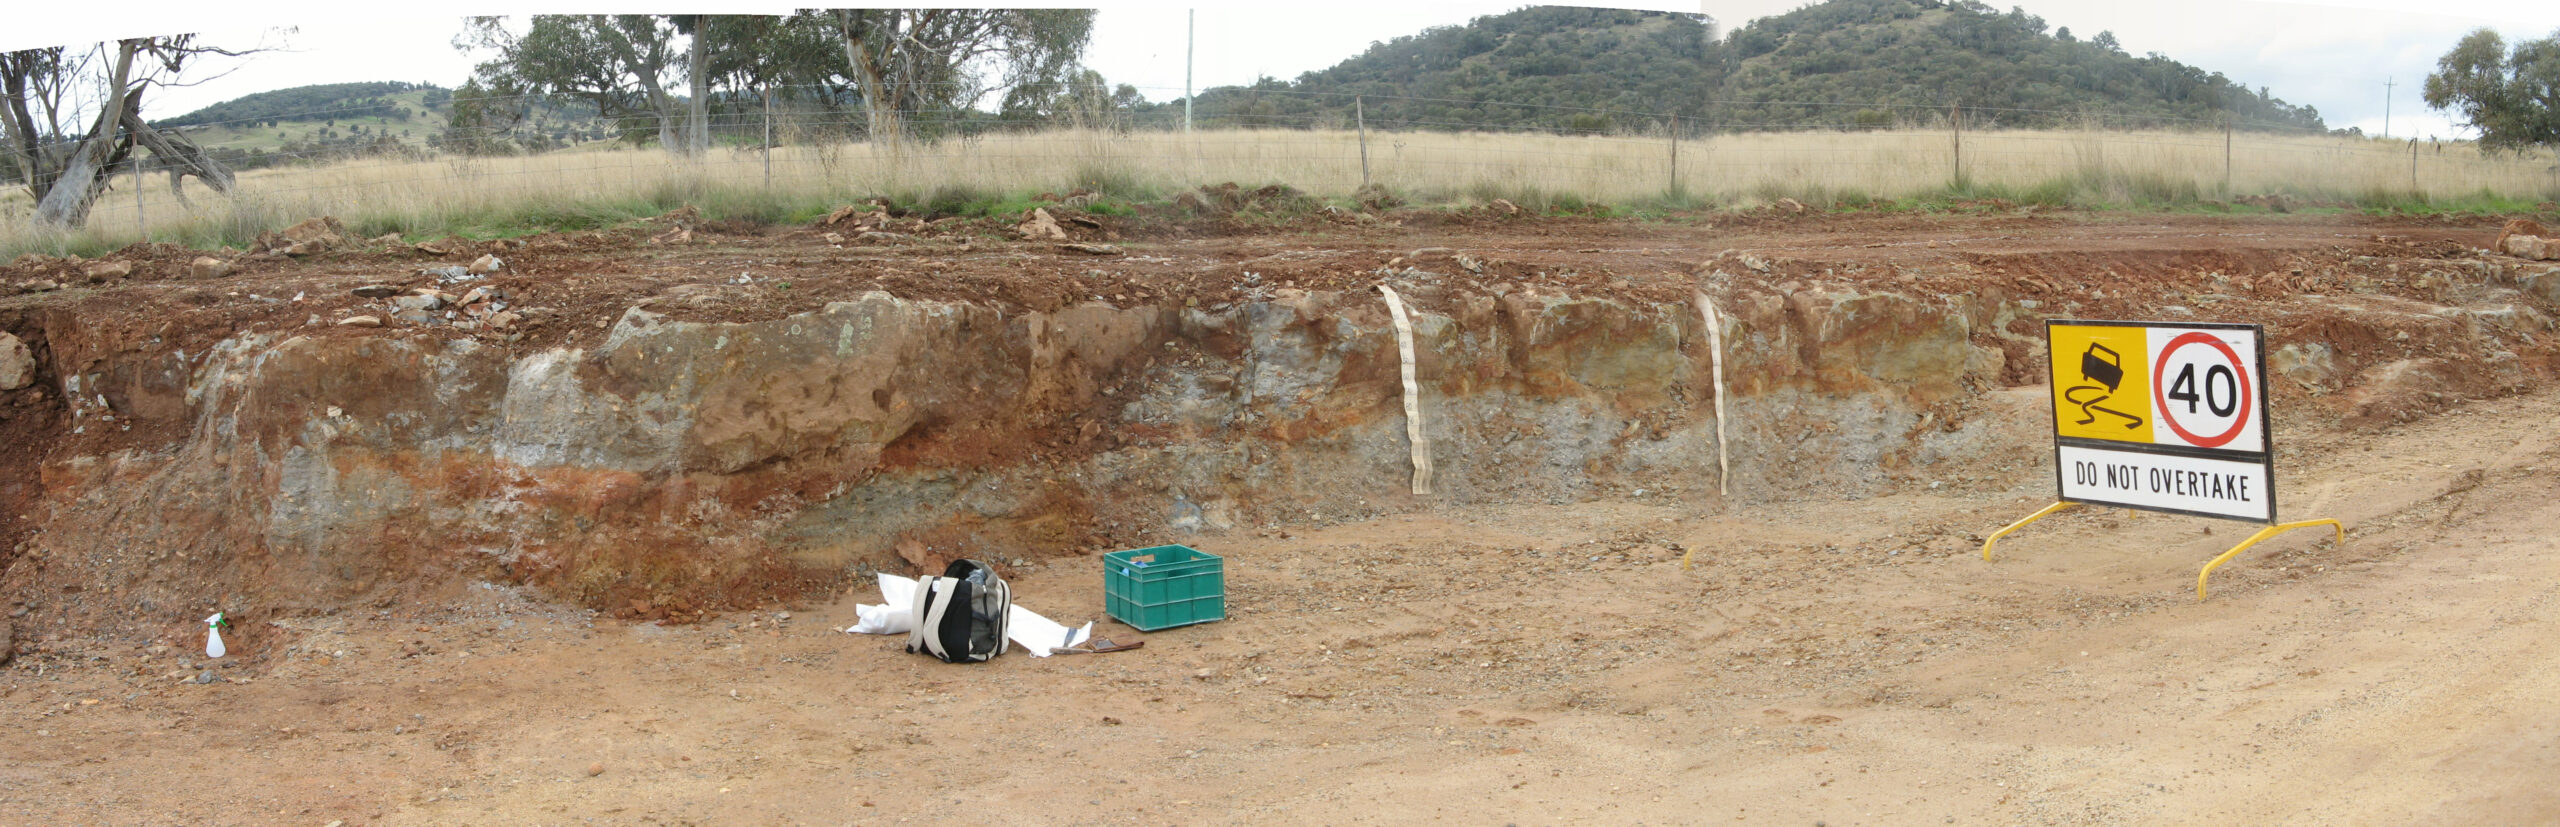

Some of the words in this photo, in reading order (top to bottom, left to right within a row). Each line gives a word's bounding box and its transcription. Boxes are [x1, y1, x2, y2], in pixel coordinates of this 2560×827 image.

[2168, 362, 2237, 418] 40
[2076, 461, 2097, 487] DO
[2107, 464, 2139, 491] NOT
[2150, 468, 2251, 502] OVERTAKE
